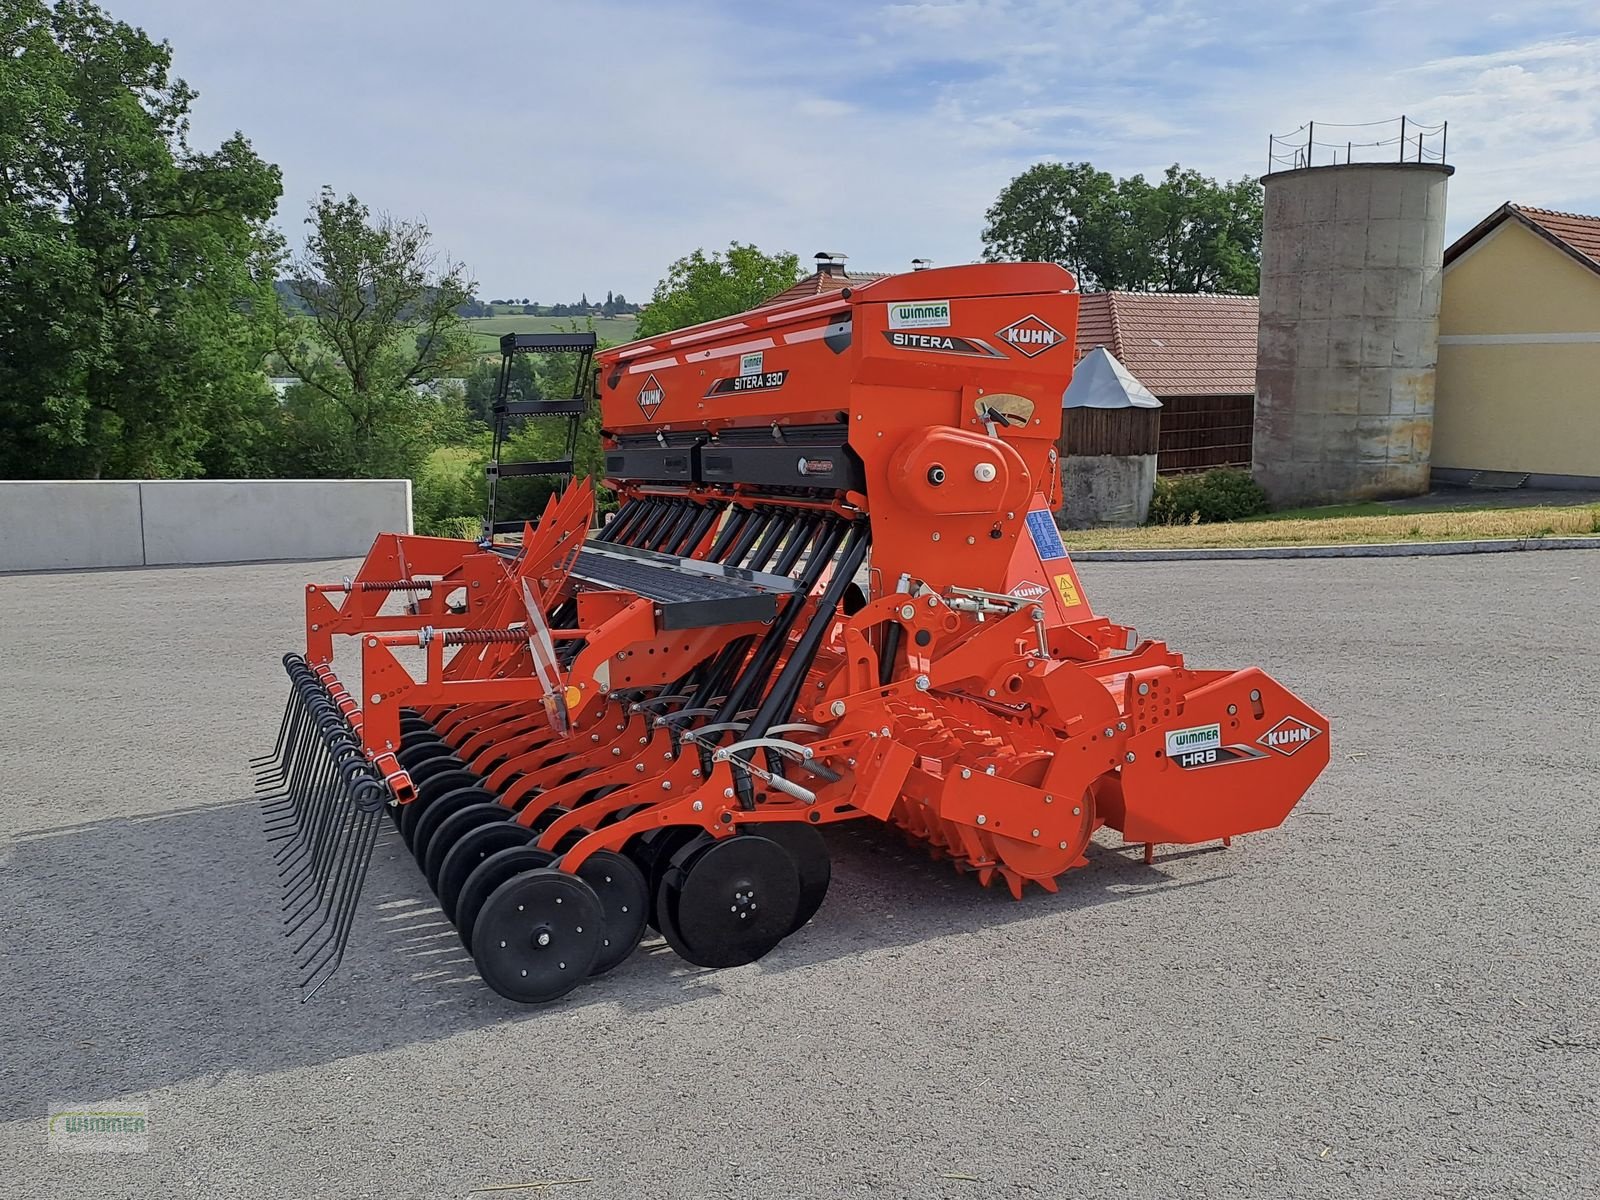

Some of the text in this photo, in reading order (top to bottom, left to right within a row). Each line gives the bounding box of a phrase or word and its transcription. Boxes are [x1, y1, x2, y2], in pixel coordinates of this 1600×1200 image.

[899, 306, 948, 320] WIMMER
[893, 333, 954, 350] SITERA
[1008, 329, 1054, 344] KUHN
[734, 372, 783, 390] SITERA 330
[641, 389, 661, 406] KUHN
[1014, 587, 1042, 597] KUHN
[1176, 729, 1219, 746] WIMMER
[1268, 728, 1311, 746] KUHN
[1182, 750, 1216, 767] HRB
